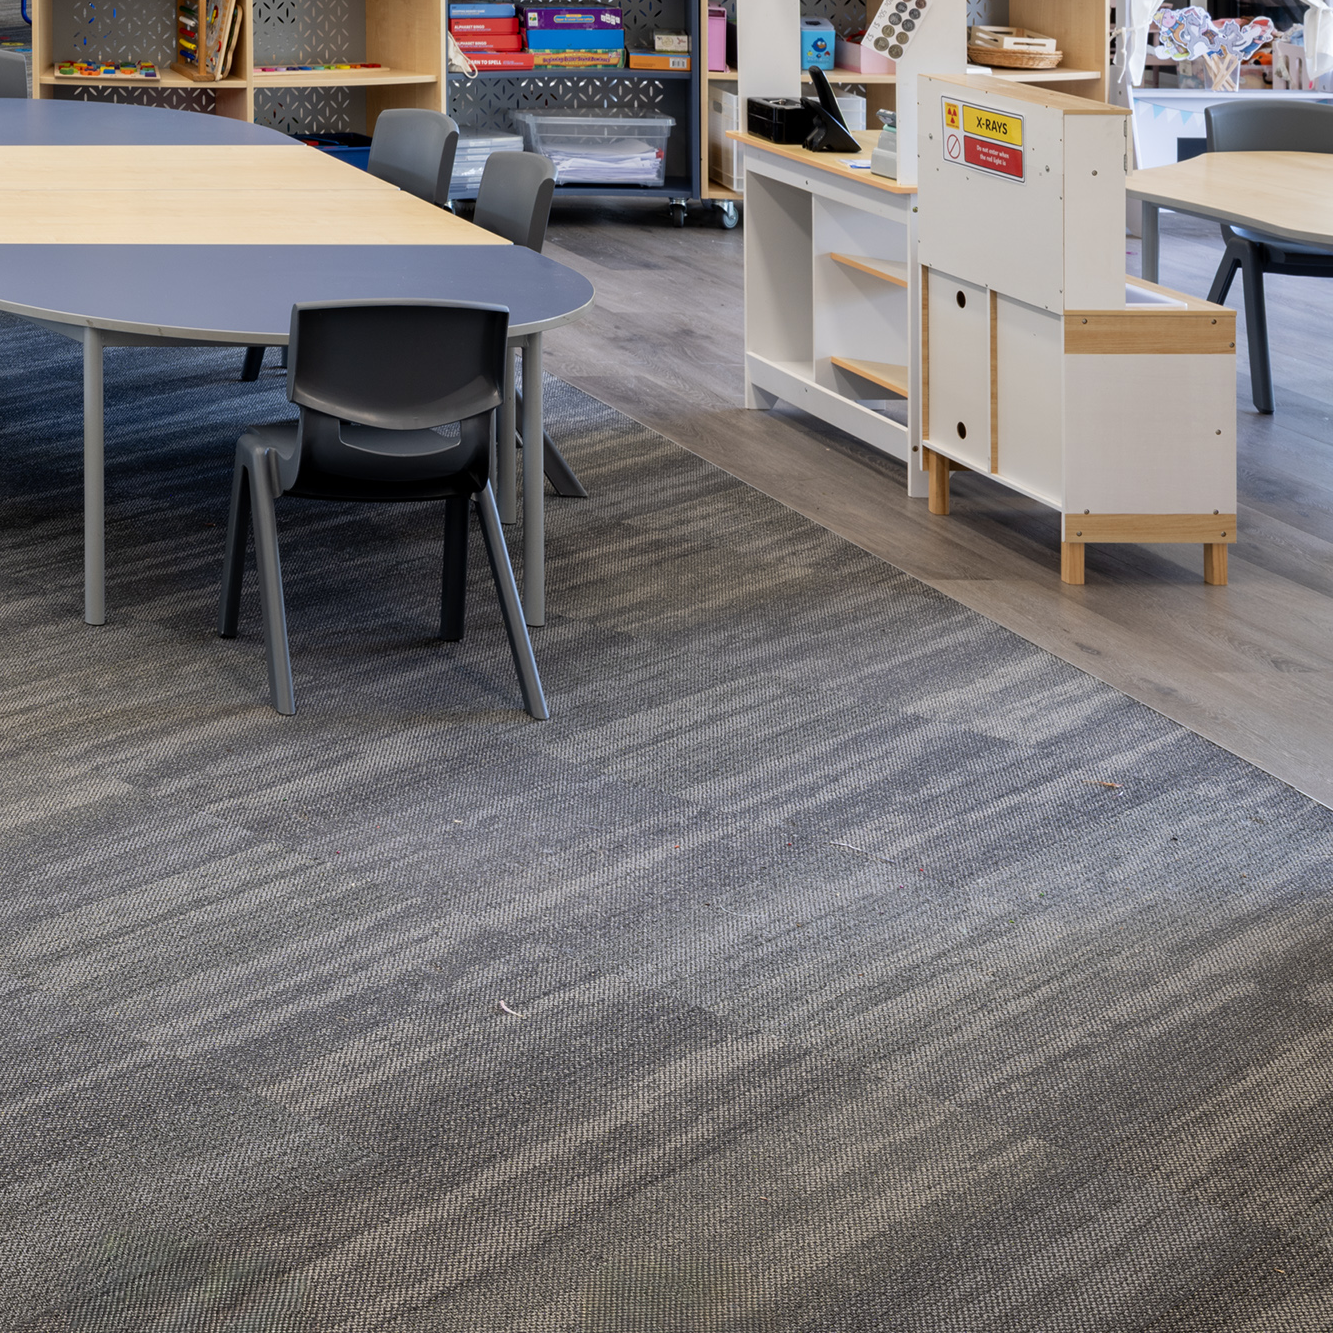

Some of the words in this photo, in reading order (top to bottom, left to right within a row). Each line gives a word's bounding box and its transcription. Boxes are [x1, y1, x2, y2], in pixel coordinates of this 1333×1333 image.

[976, 116, 1008, 135] X-RAYS
[999, 151, 1010, 159] when
[993, 157, 1002, 165] light
